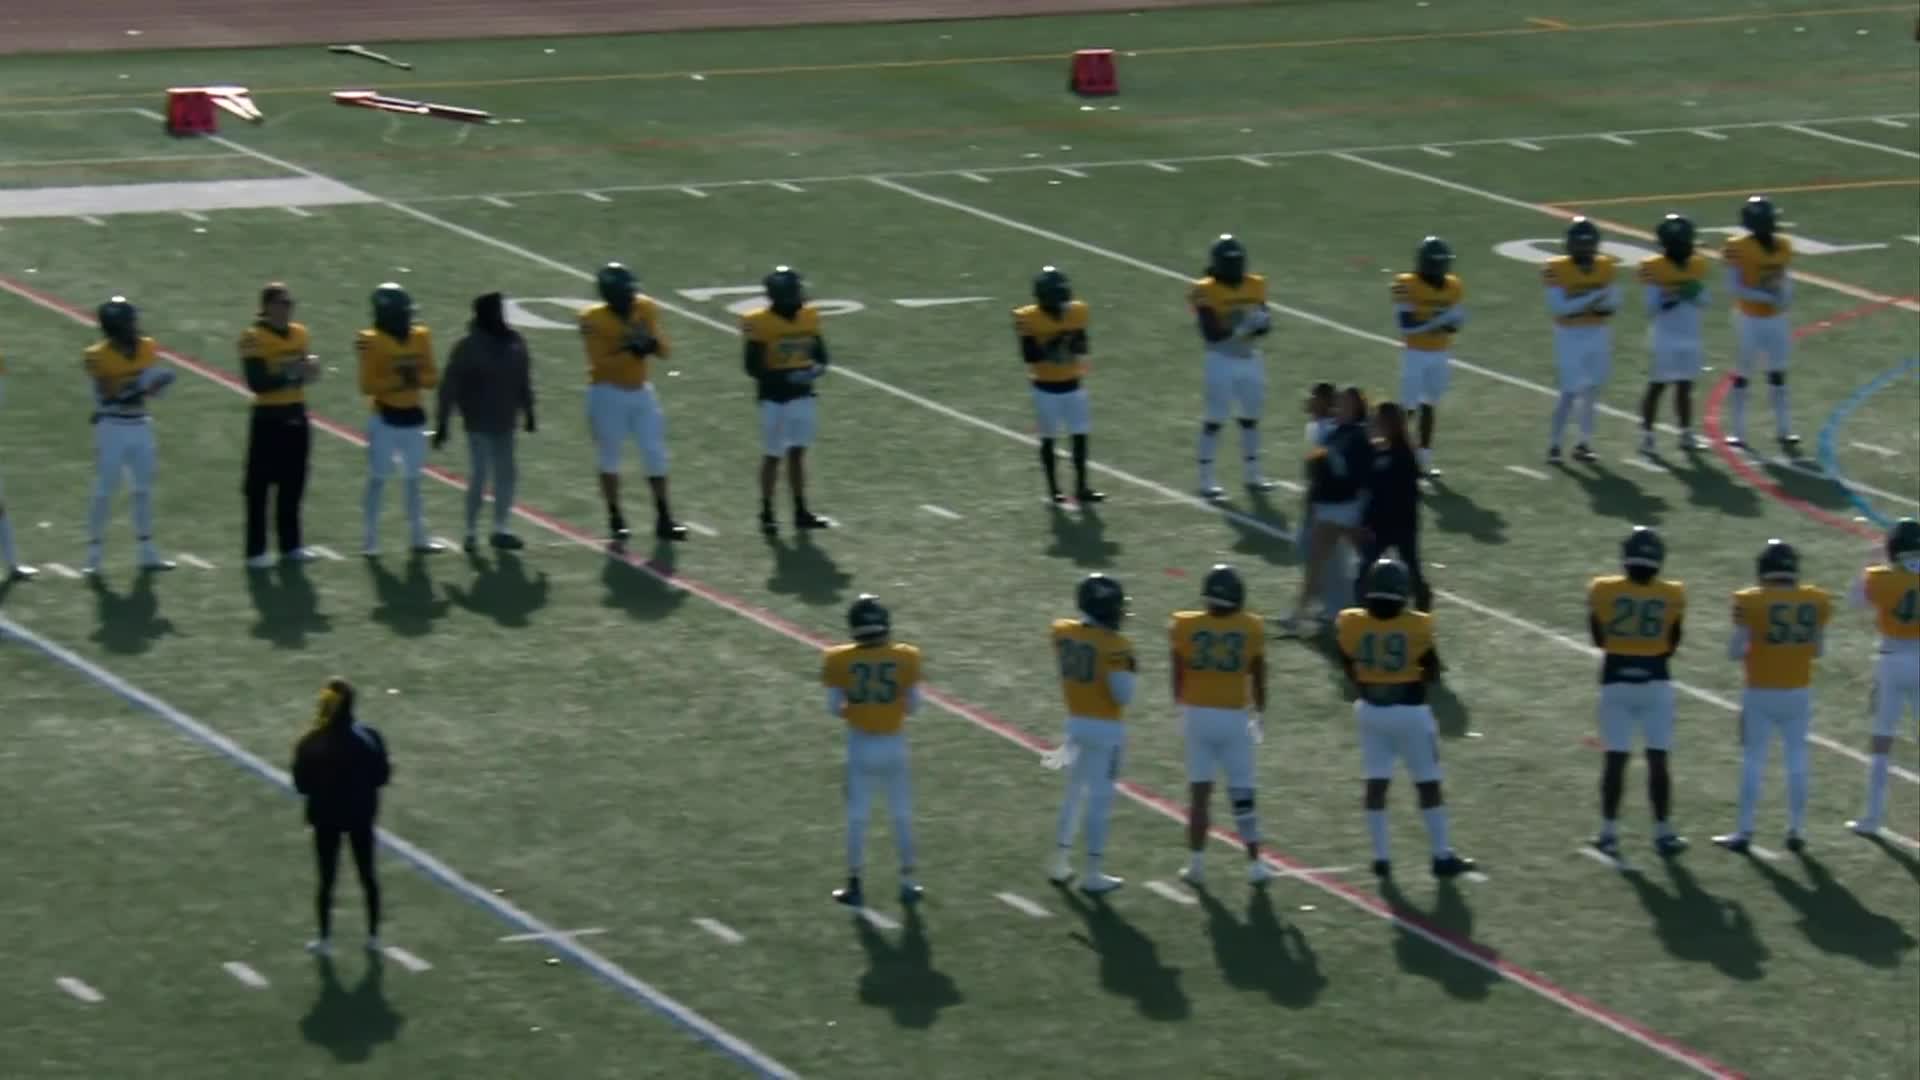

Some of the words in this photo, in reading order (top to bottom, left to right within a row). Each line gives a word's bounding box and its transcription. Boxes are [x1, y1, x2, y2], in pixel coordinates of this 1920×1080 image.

[1606, 597, 1667, 639] 26
[1767, 602, 1819, 645] 59
[1190, 631, 1246, 672] 33
[1358, 632, 1409, 672] 49
[848, 661, 899, 705] 35
